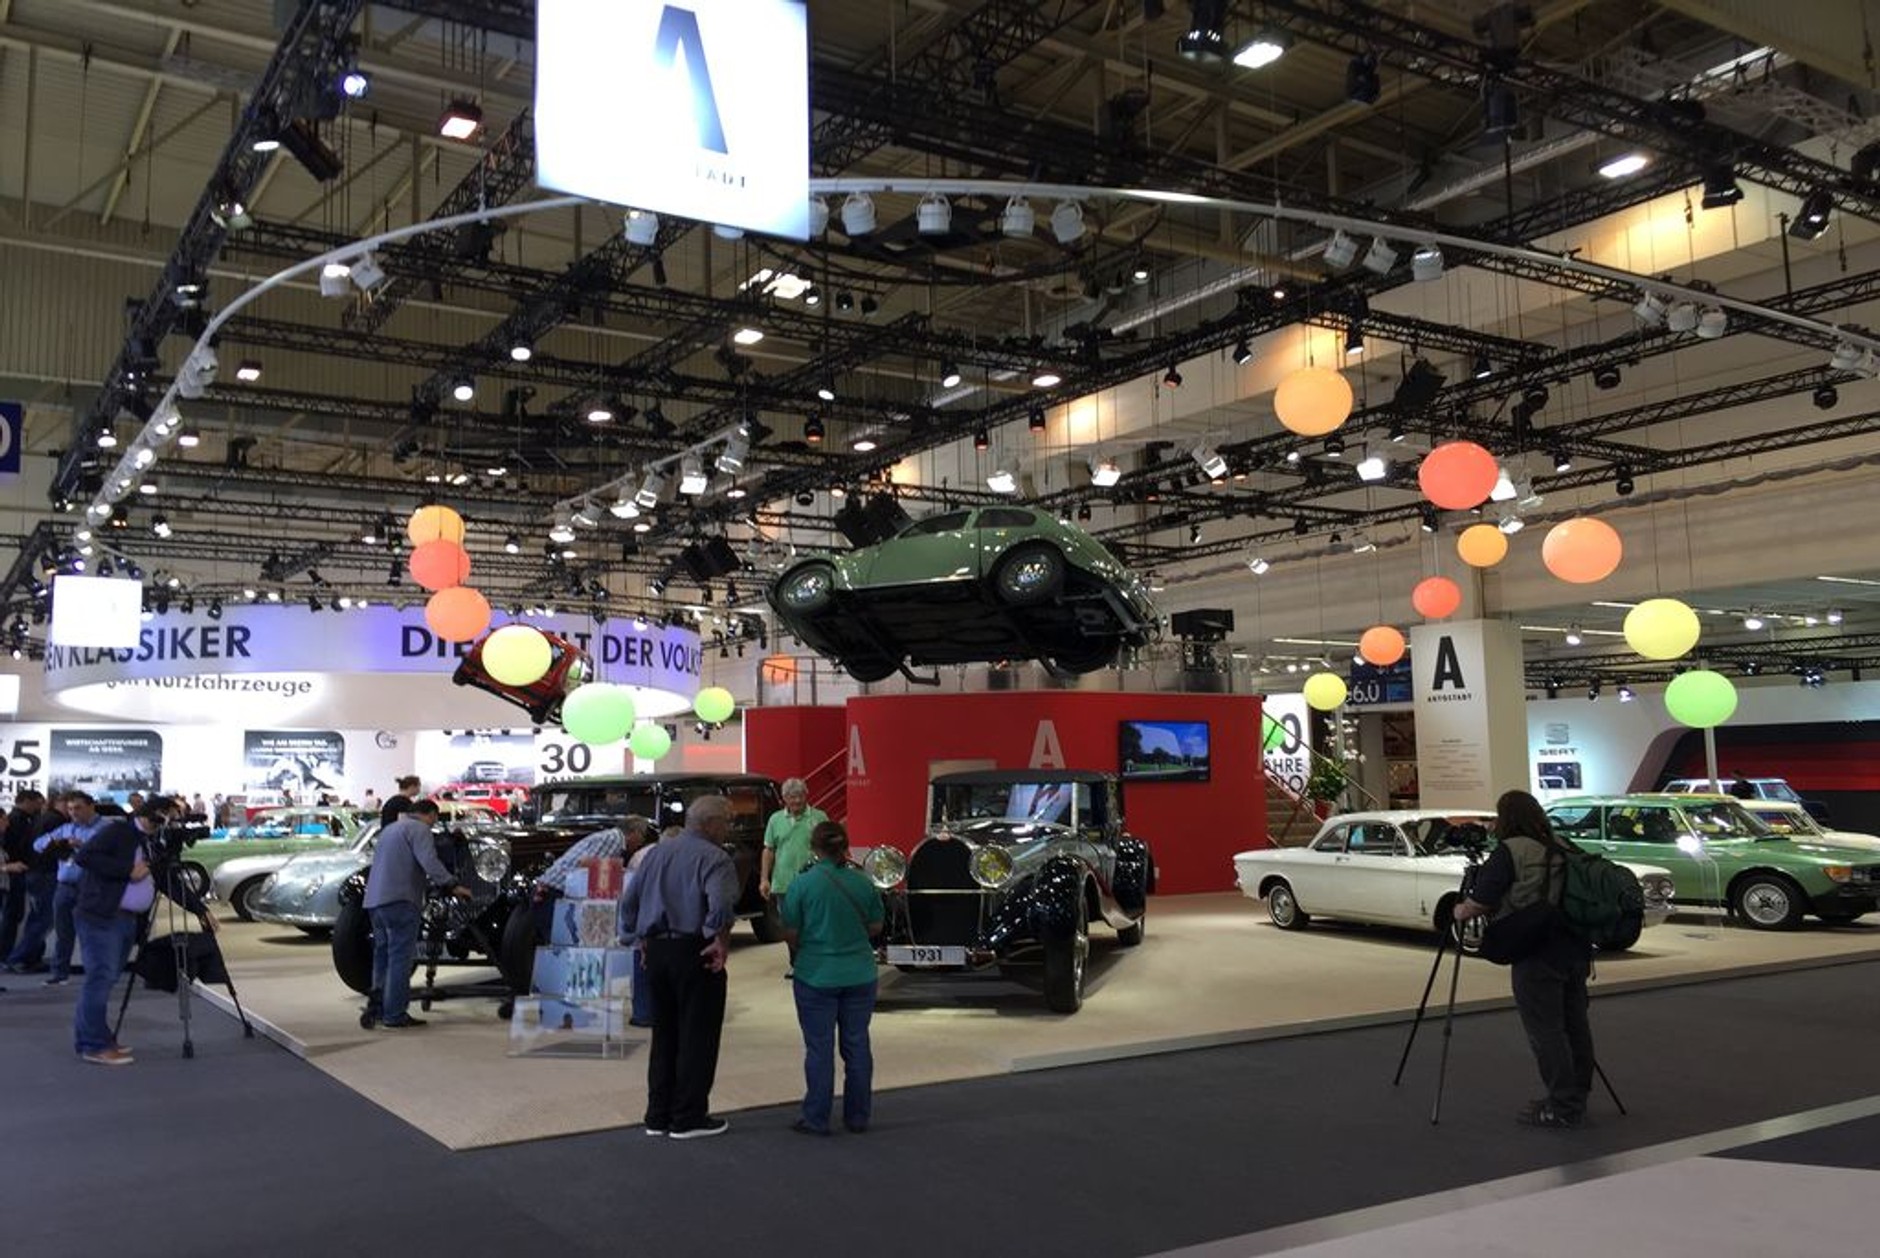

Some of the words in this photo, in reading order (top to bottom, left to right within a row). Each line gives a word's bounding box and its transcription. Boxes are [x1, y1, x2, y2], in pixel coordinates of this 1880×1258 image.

[602, 636, 654, 668] DER
[1433, 636, 1465, 690] A
[540, 743, 592, 774] 30
[848, 724, 866, 776] A
[1028, 720, 1066, 769] A
[1538, 748, 1579, 756] SEAT
[911, 948, 943, 962] 1931
